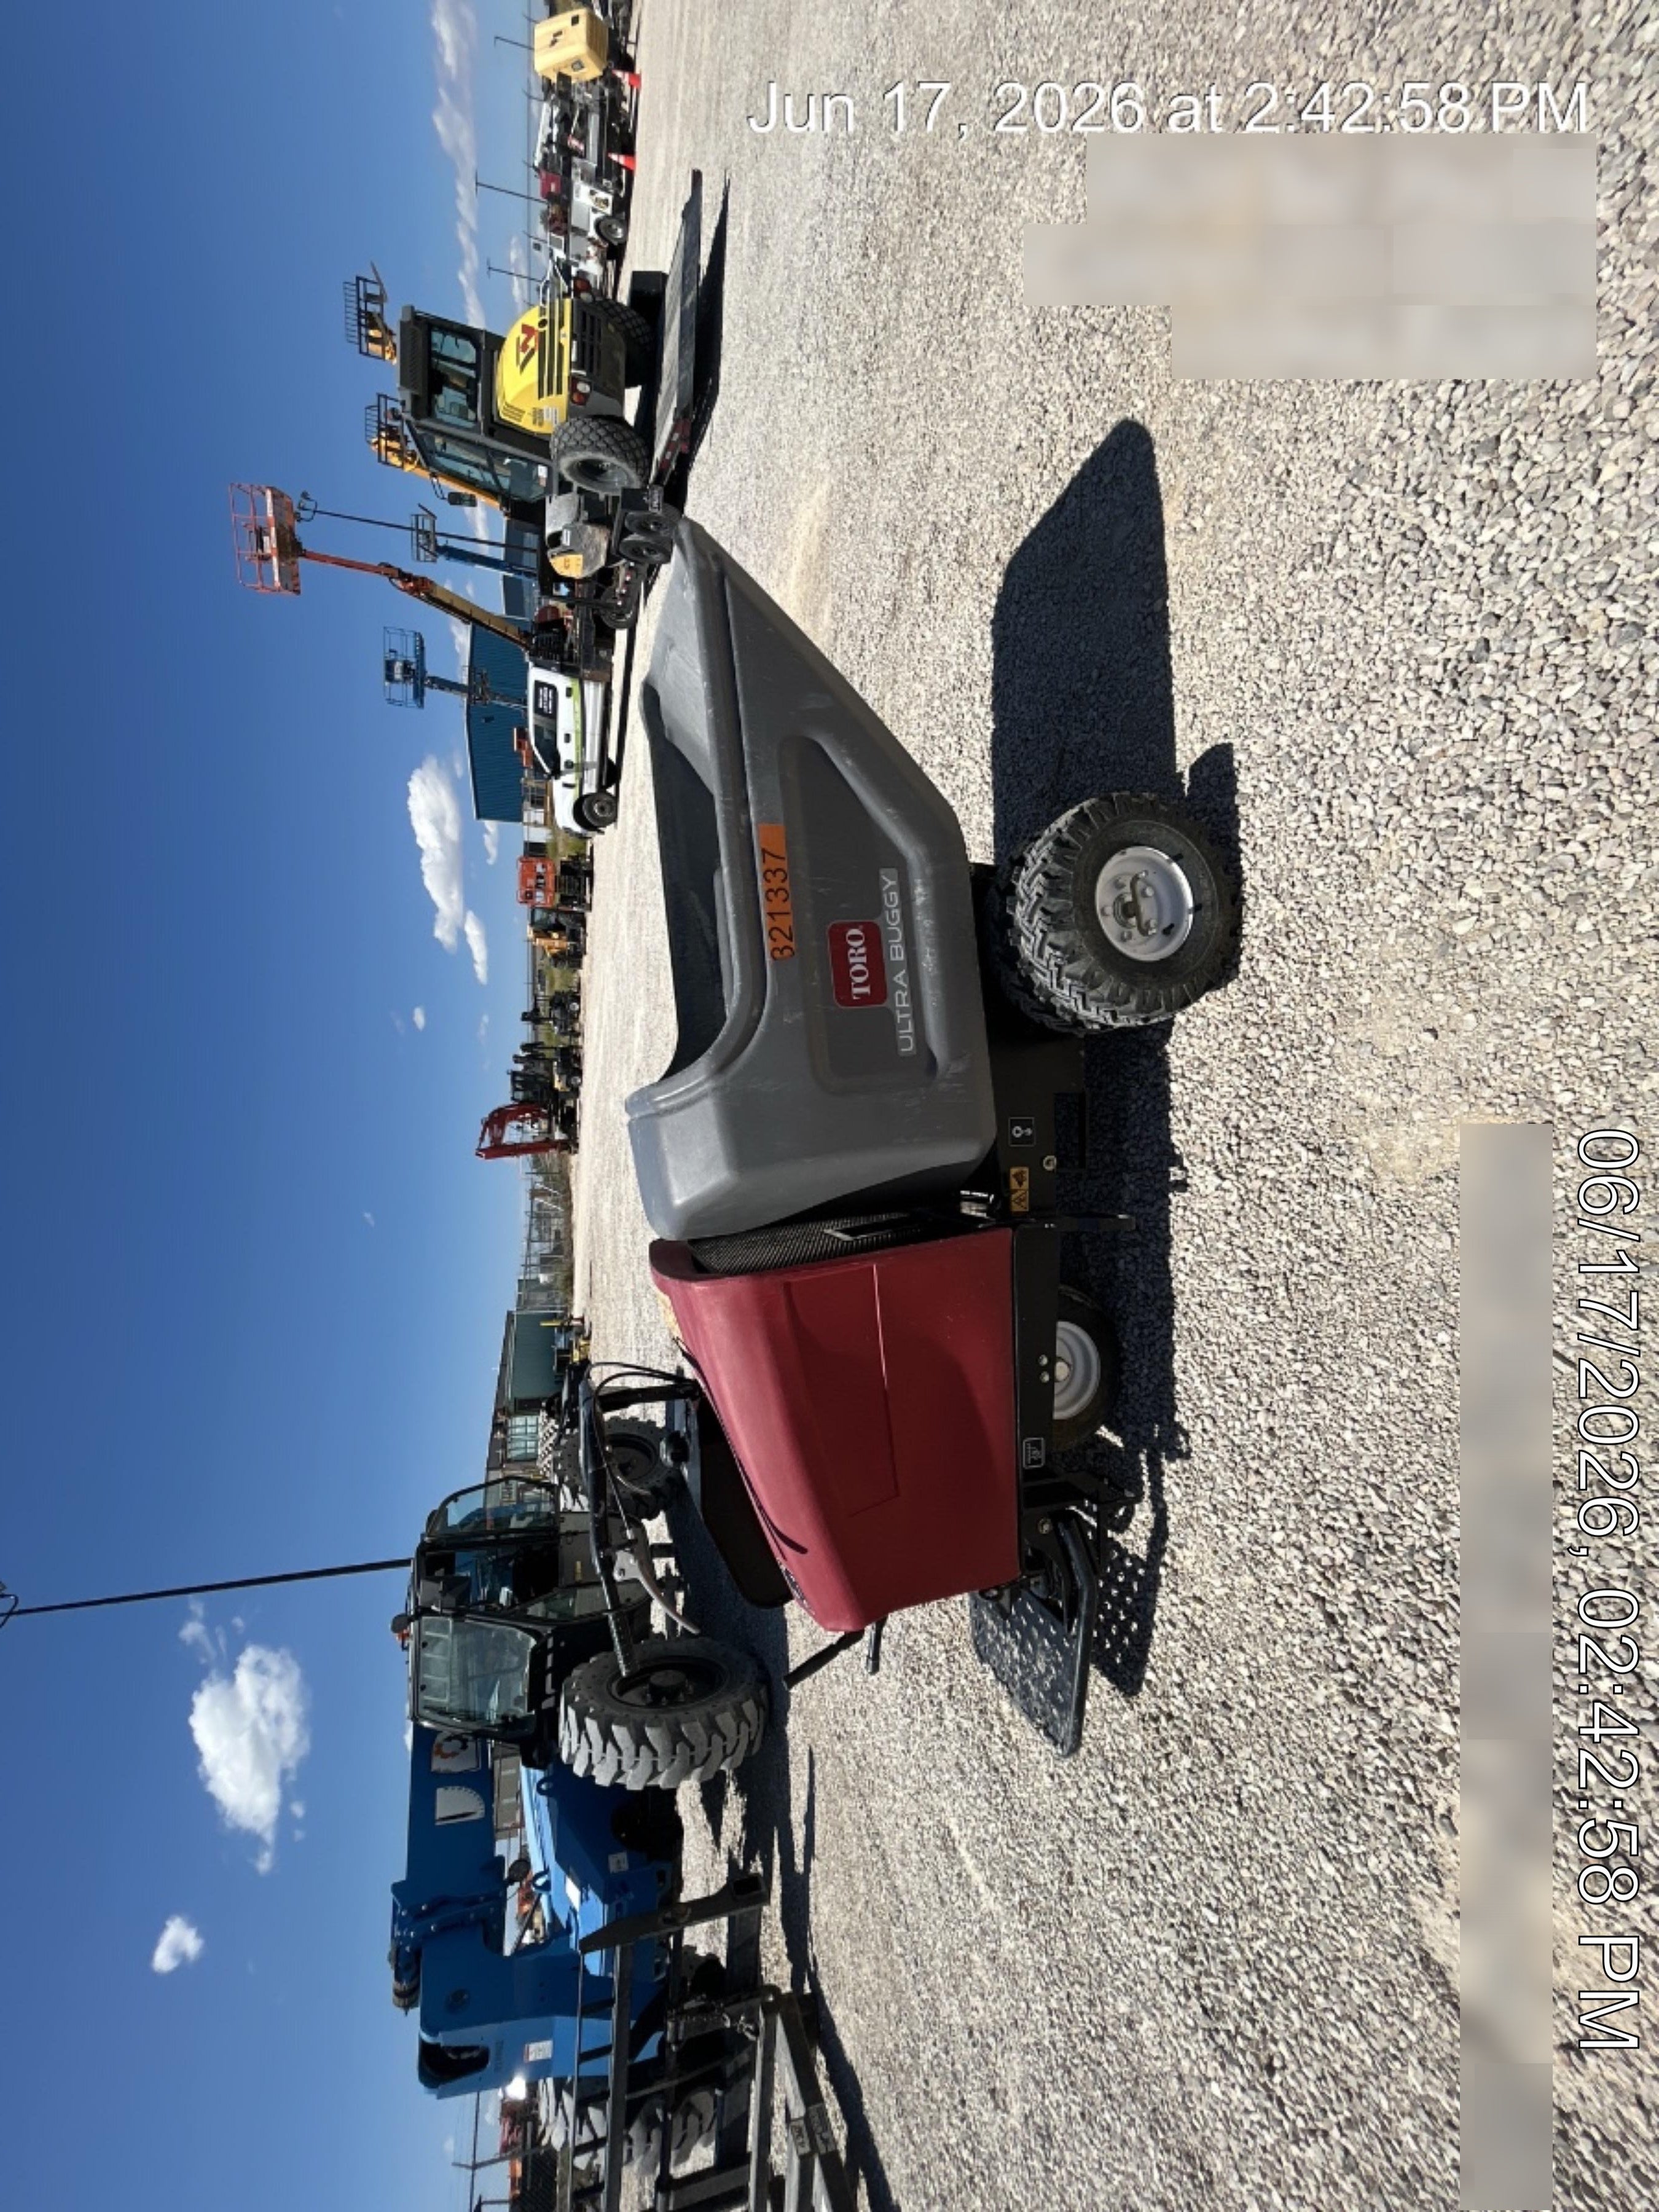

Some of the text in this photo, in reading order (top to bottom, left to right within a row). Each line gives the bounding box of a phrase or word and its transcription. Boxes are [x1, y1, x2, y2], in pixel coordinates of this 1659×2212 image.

[761, 847, 796, 961] 321337
[845, 927, 871, 999] TORO
[880, 873, 914, 1051] ULTRA BUGGY
